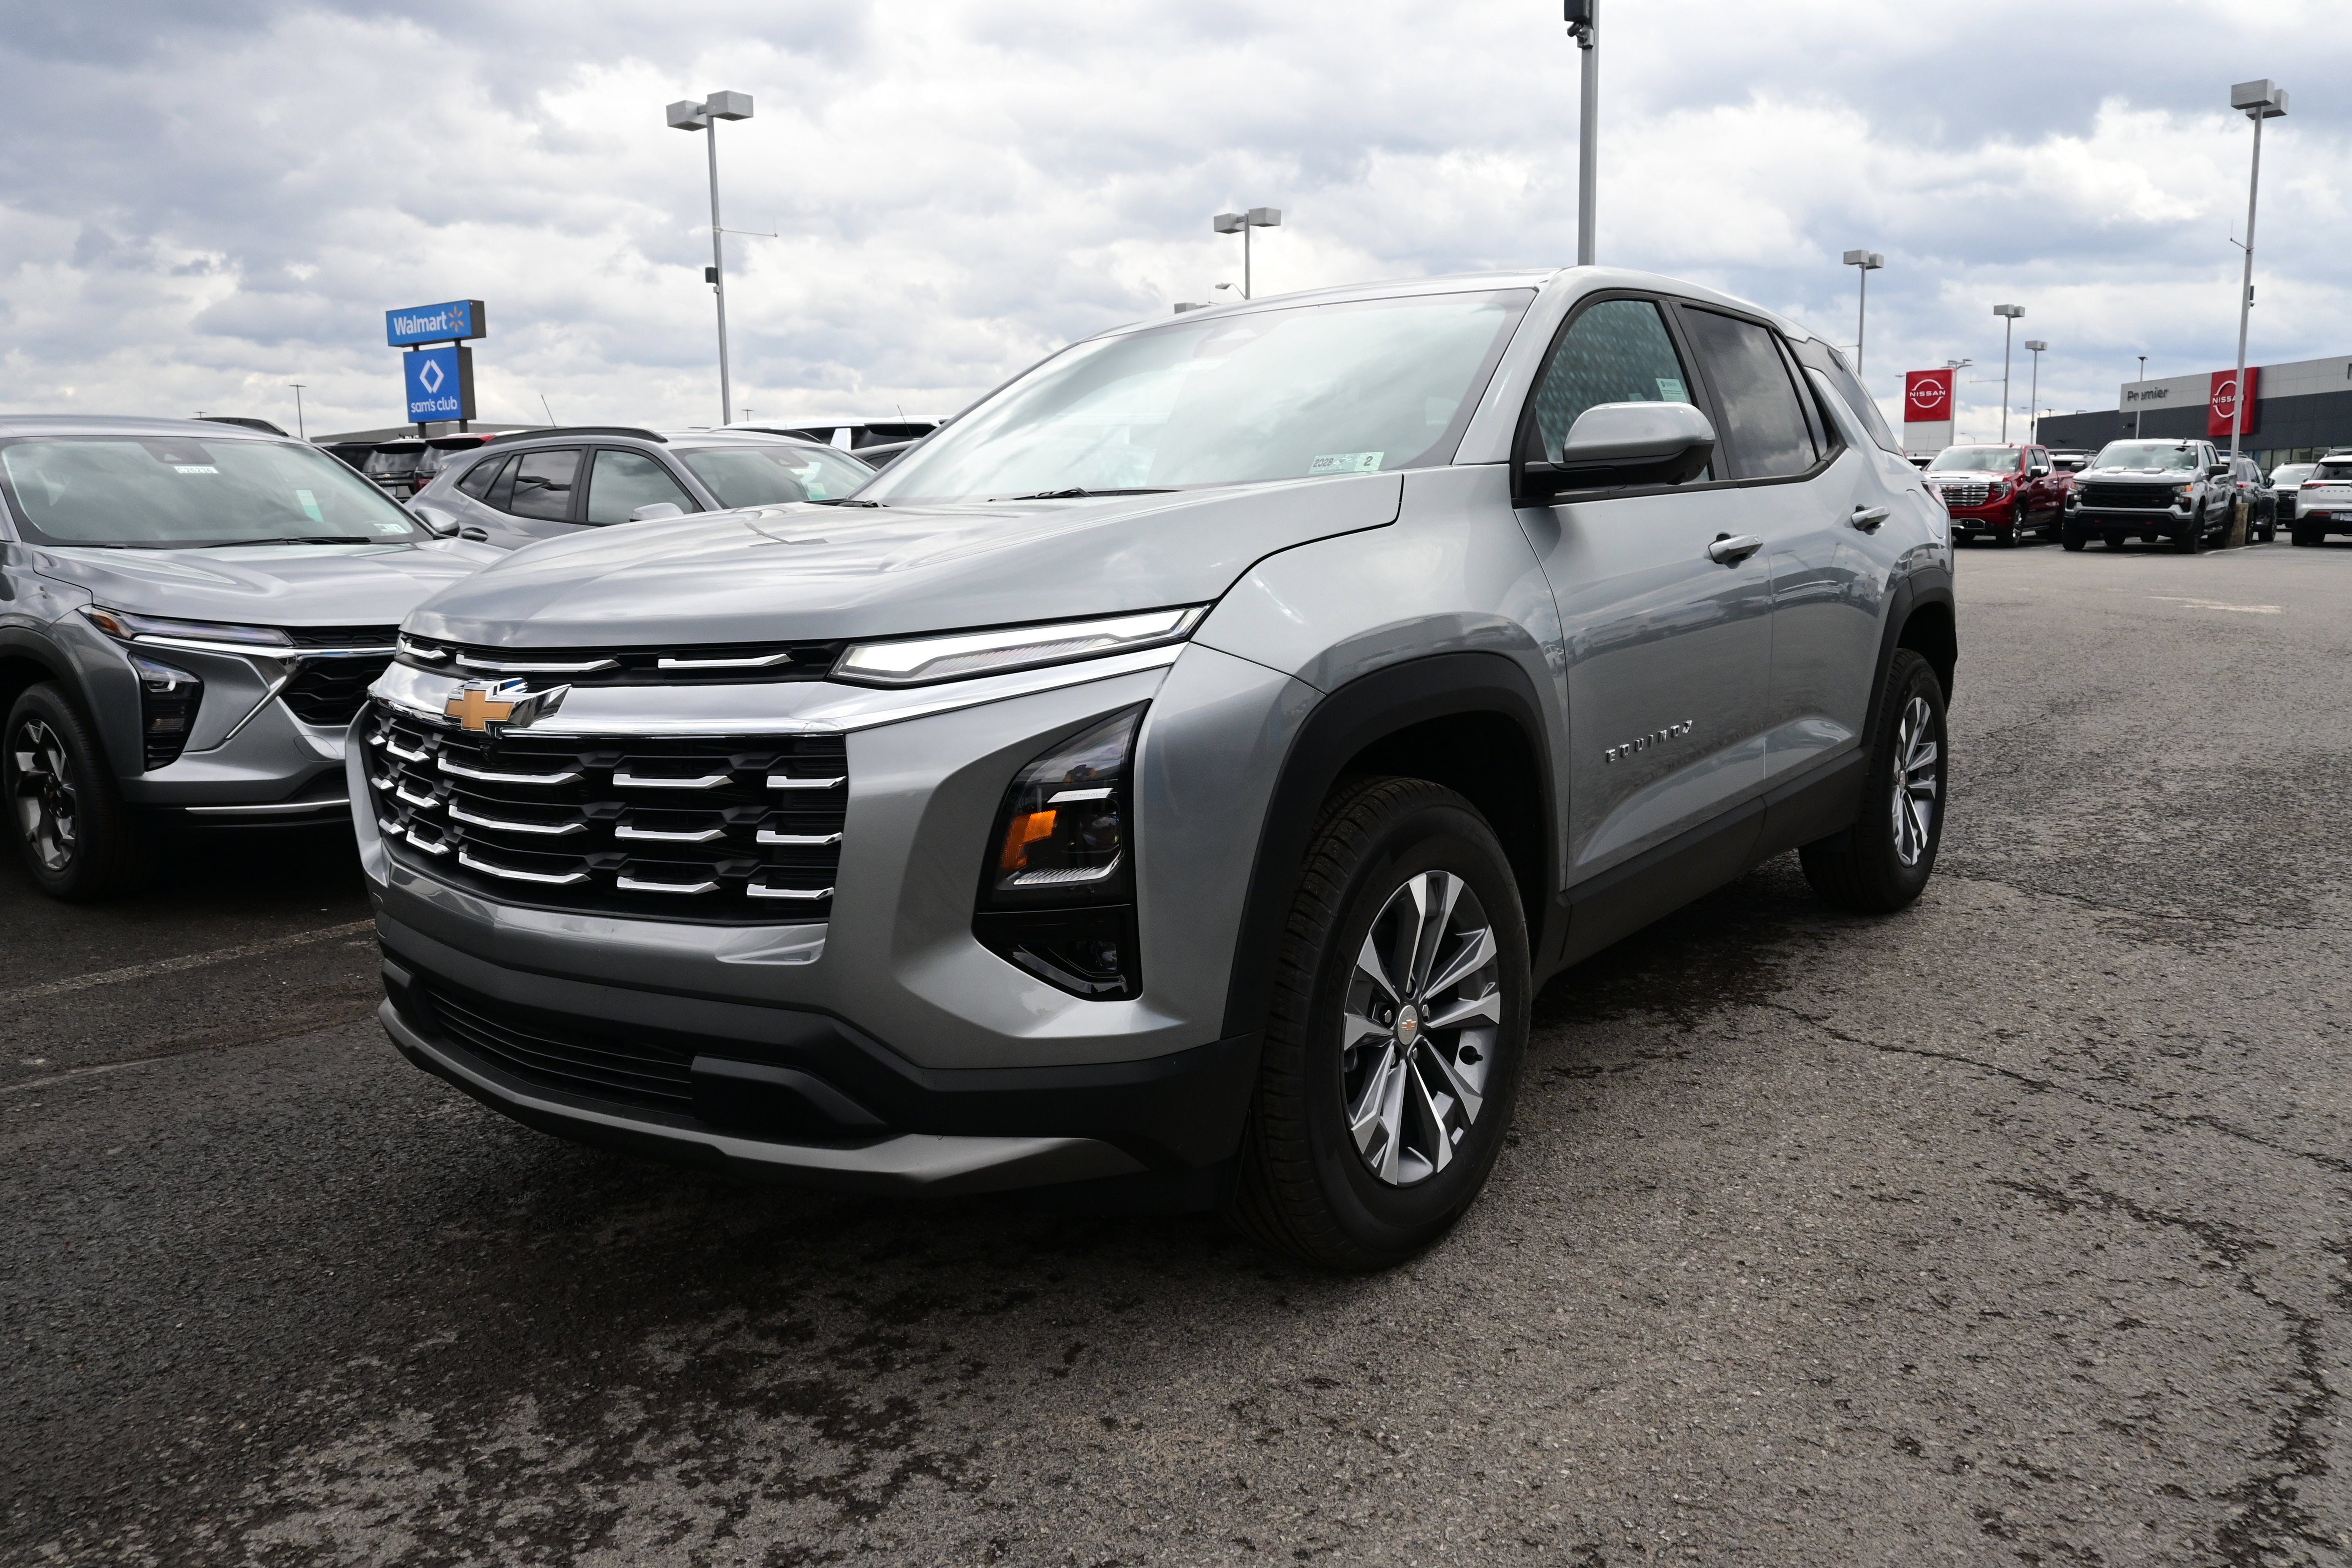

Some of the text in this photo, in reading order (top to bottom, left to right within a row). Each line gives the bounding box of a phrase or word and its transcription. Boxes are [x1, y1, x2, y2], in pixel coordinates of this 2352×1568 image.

[394, 311, 447, 335] Walmart
[411, 396, 457, 413] sam's club
[2213, 395, 2244, 404] NISSA
[1313, 456, 1373, 468] 2028 2
[1605, 720, 1693, 763] EQUINOX
